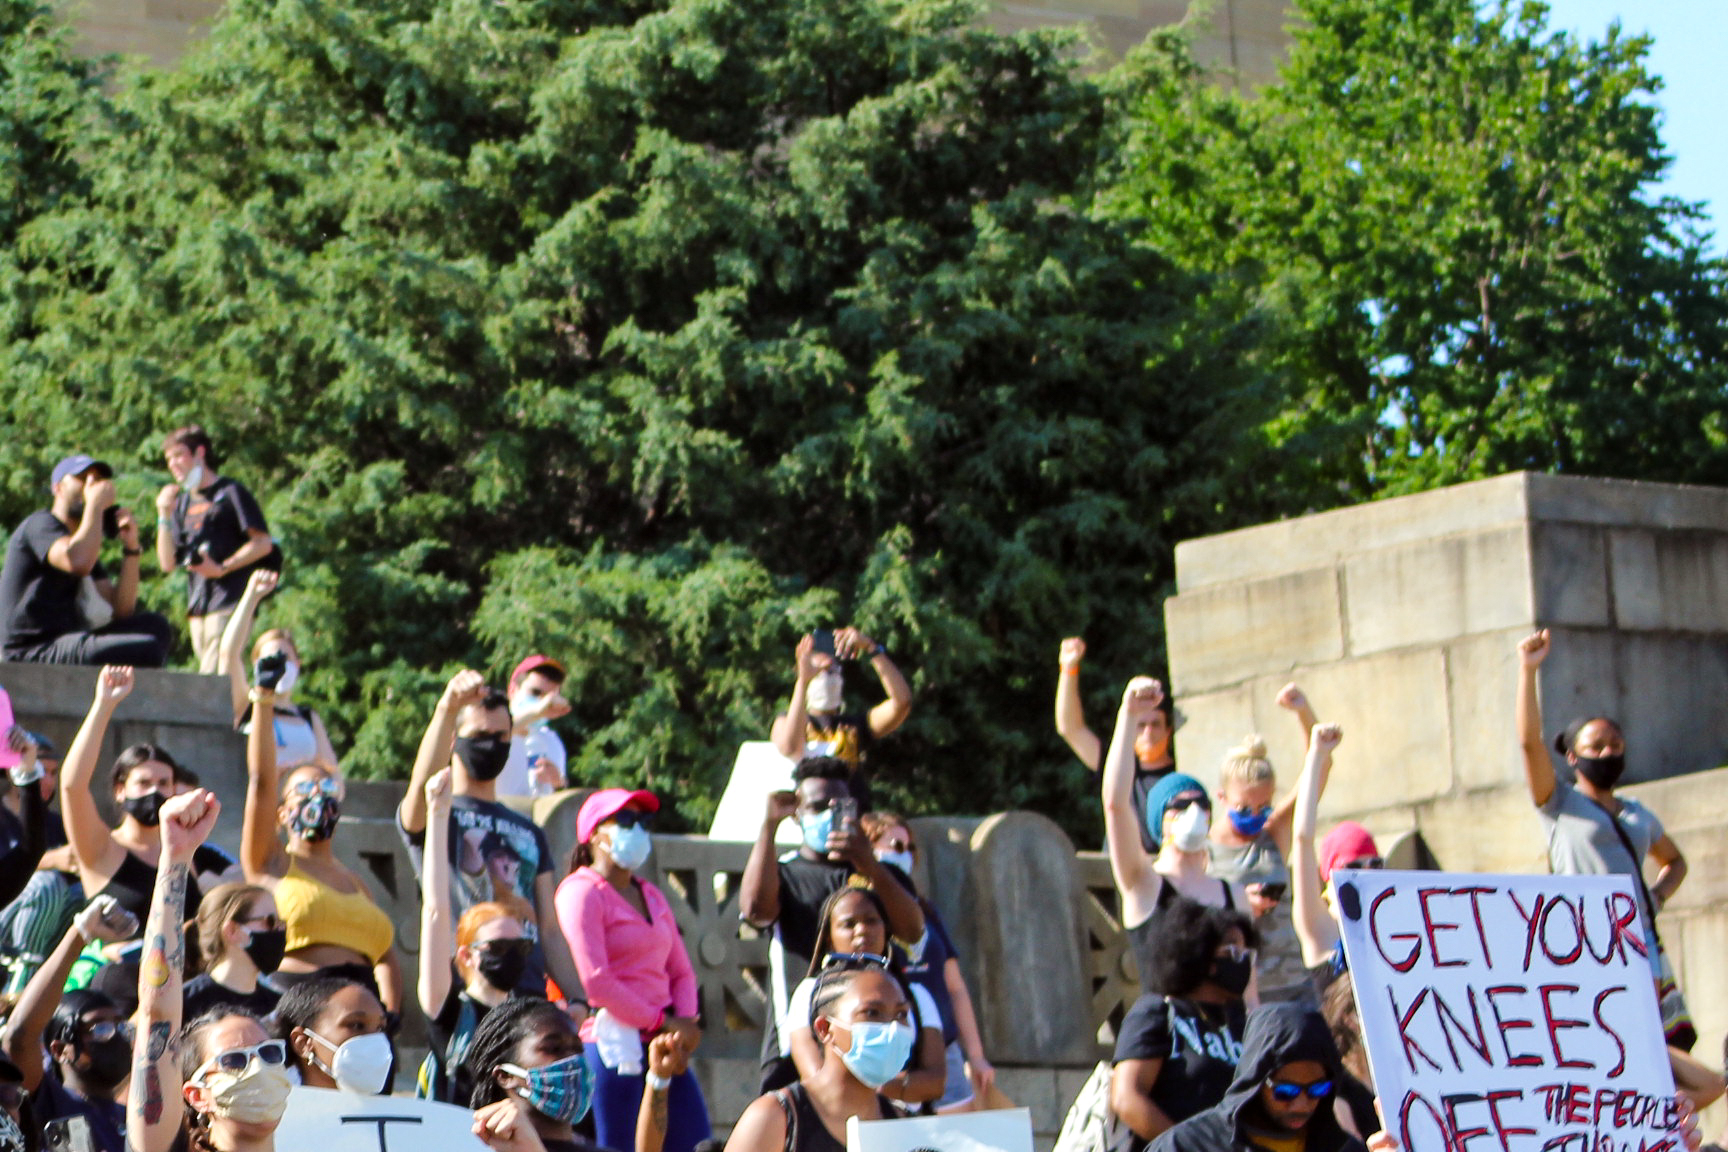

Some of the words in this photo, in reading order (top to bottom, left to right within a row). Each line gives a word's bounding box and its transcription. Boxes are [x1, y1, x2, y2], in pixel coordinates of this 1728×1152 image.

[1369, 886, 1498, 974] GET
[1507, 888, 1649, 973] YOUR
[1386, 984, 1628, 1079] KNEES
[1534, 1083, 1592, 1127] THE
